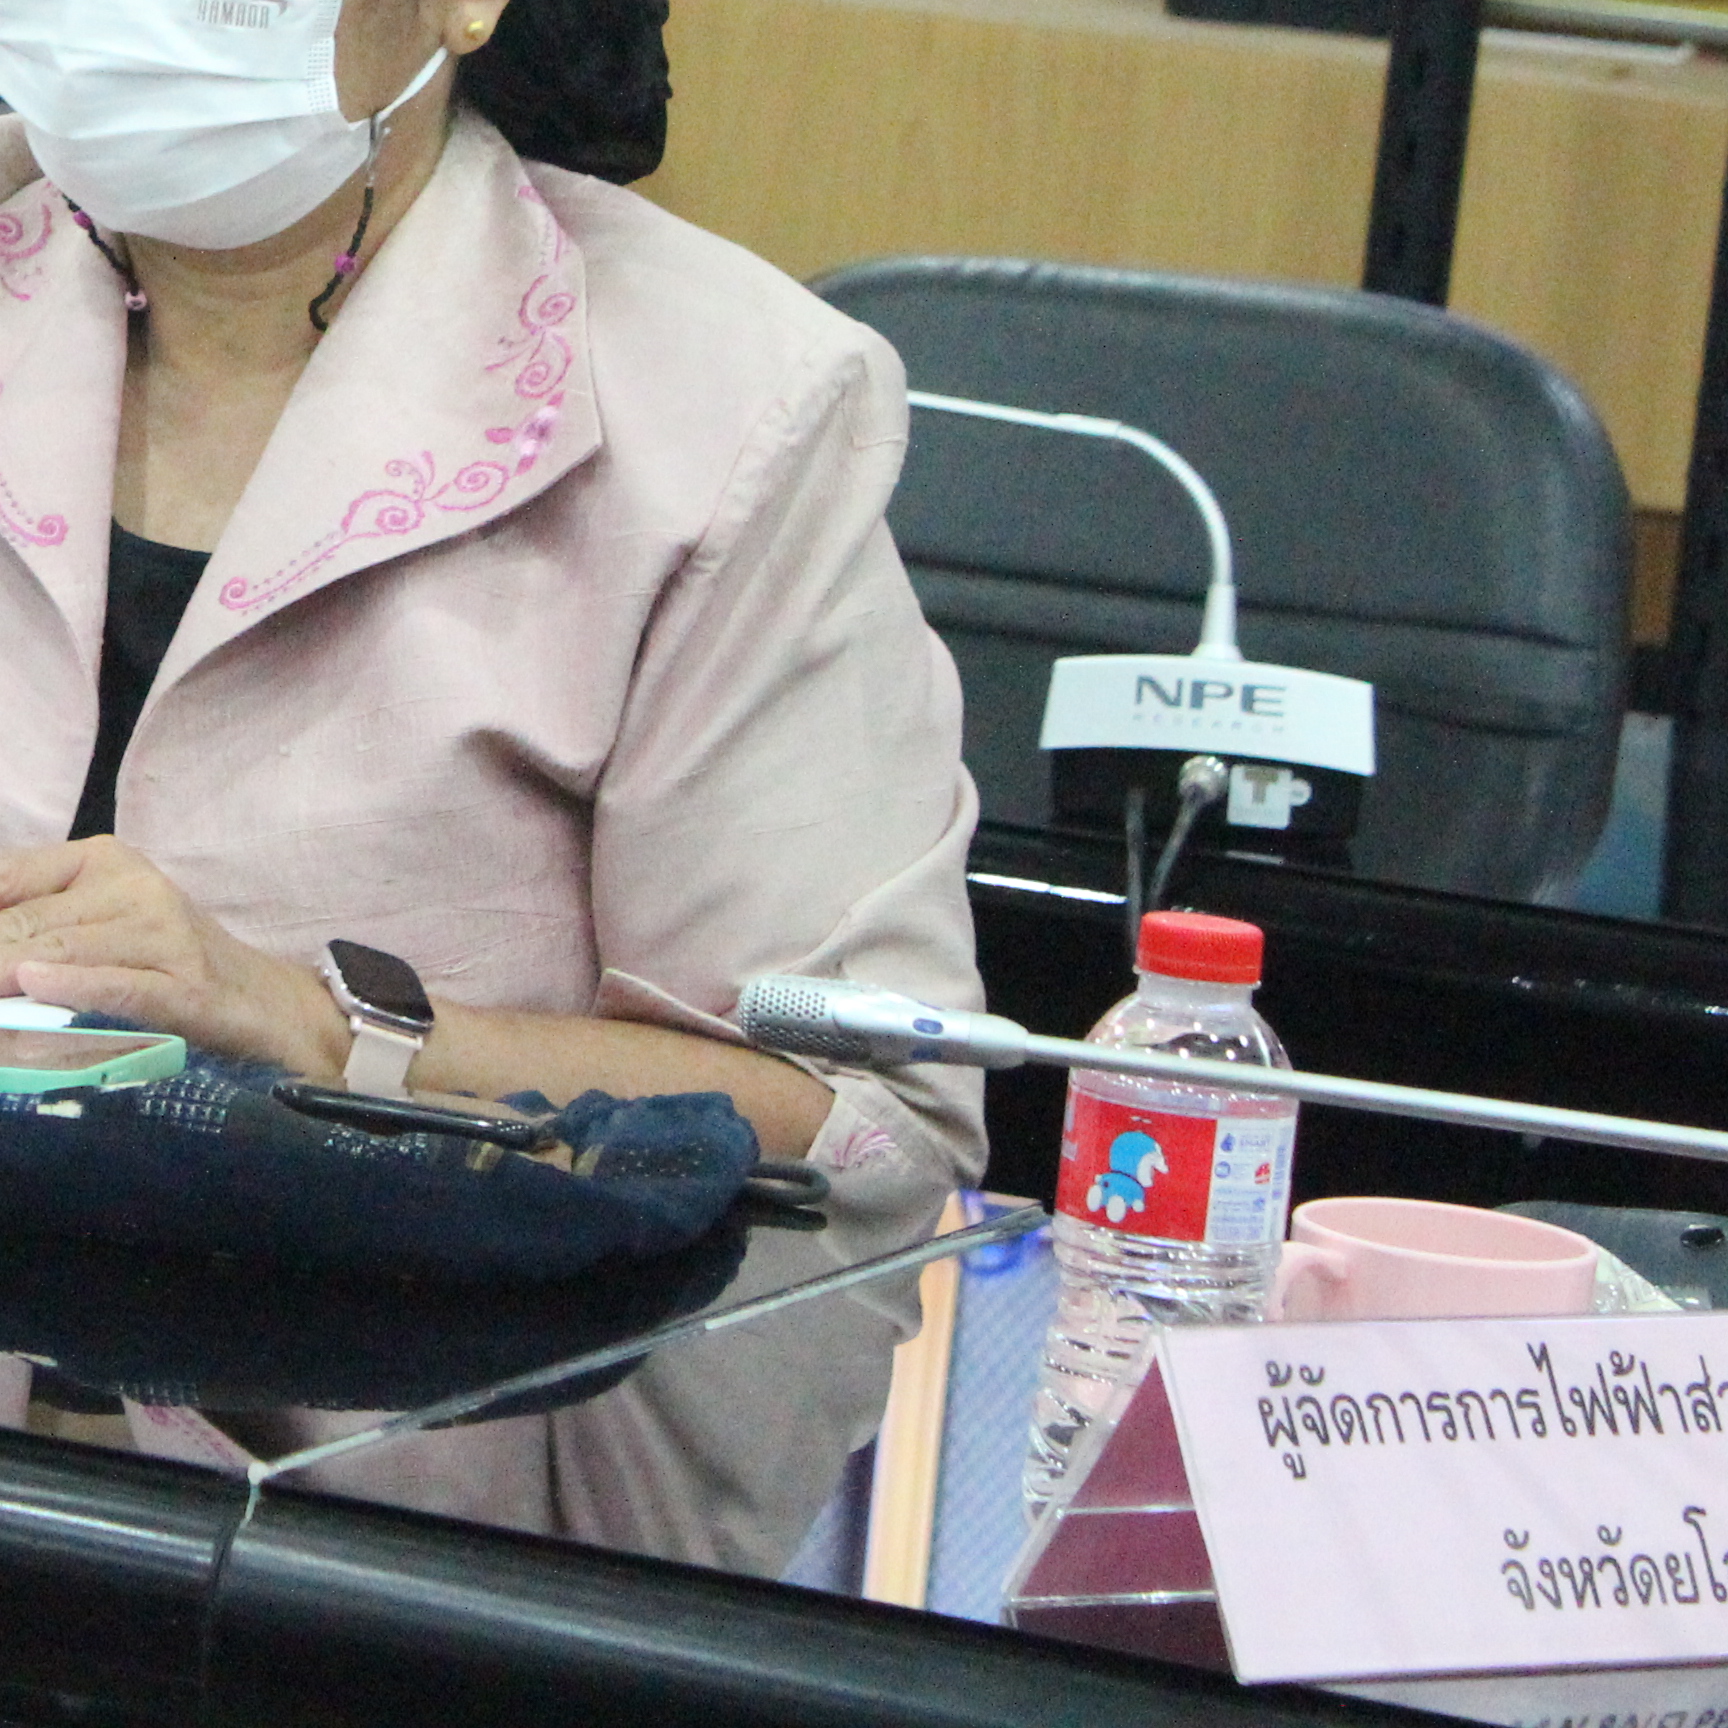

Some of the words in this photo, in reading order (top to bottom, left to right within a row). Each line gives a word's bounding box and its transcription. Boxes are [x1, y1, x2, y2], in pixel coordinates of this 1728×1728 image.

[1135, 675, 1287, 717] NPE
[1501, 1506, 1728, 1611] จังหวัดยโ
